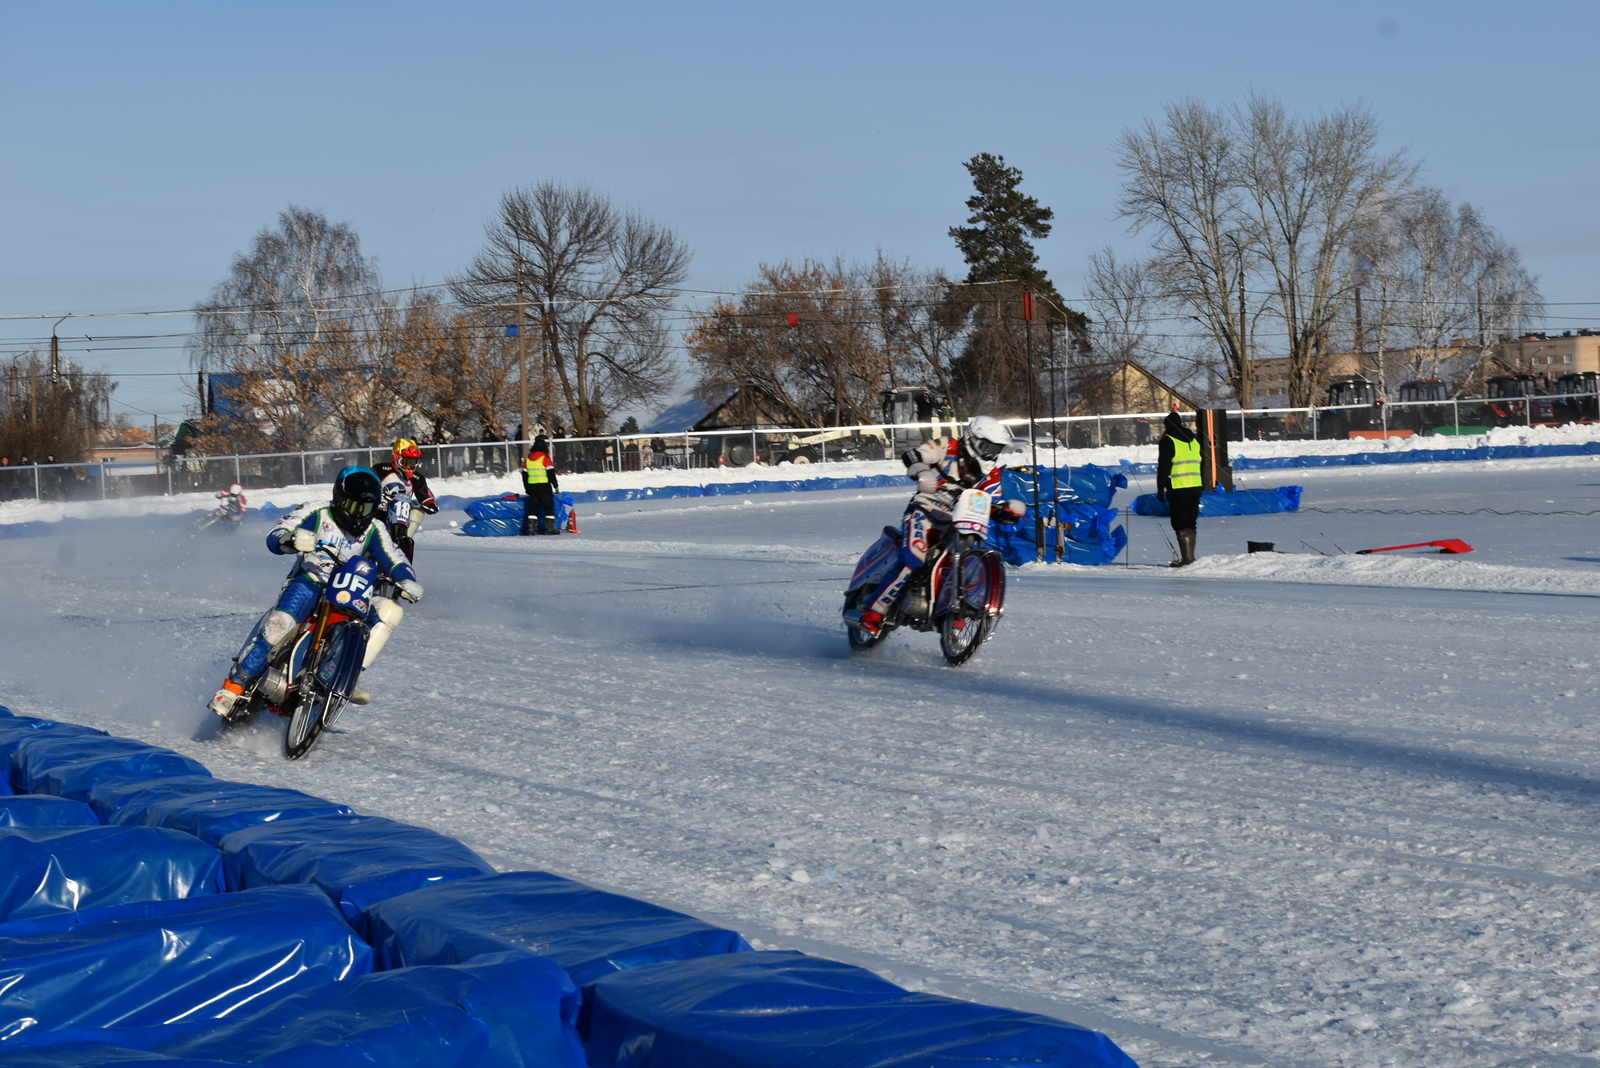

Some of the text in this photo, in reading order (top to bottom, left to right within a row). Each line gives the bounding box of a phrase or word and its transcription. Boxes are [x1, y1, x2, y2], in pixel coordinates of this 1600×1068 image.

[394, 501, 411, 519] 18
[330, 534, 352, 550] UFA
[332, 572, 374, 600] UFA
